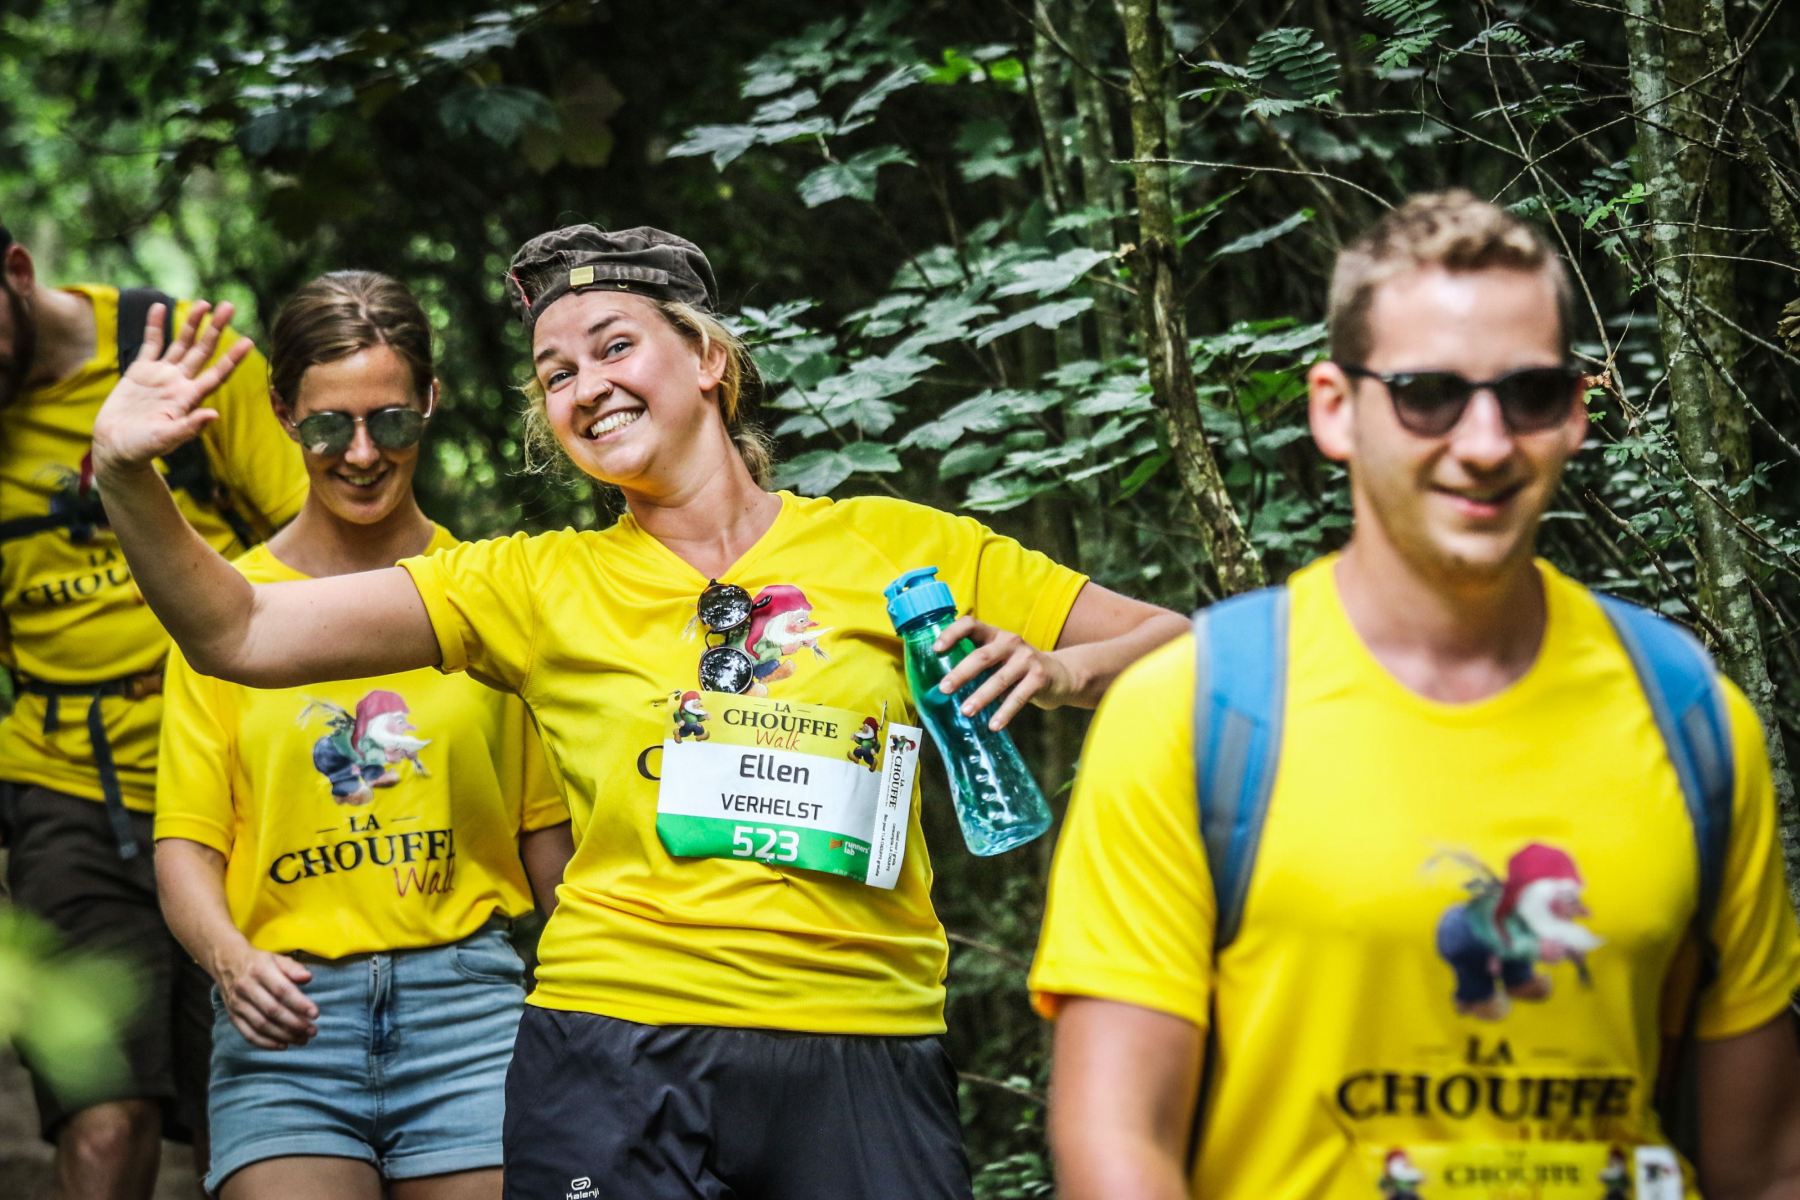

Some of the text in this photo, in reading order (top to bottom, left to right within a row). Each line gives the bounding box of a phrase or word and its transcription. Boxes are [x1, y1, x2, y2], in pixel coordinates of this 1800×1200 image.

[19, 568, 131, 603] CHOU
[722, 708, 839, 740] CHOUFFE
[774, 702, 792, 714] LA
[754, 728, 802, 752] Walk
[739, 753, 810, 785] Ellen
[889, 755, 903, 808] CHOUFFE
[720, 793, 823, 821] VERHELST
[349, 814, 381, 833] LA
[732, 825, 800, 862] 523
[1466, 1034, 1514, 1066] LA
[1337, 1069, 1635, 1122] CHOUFFE
